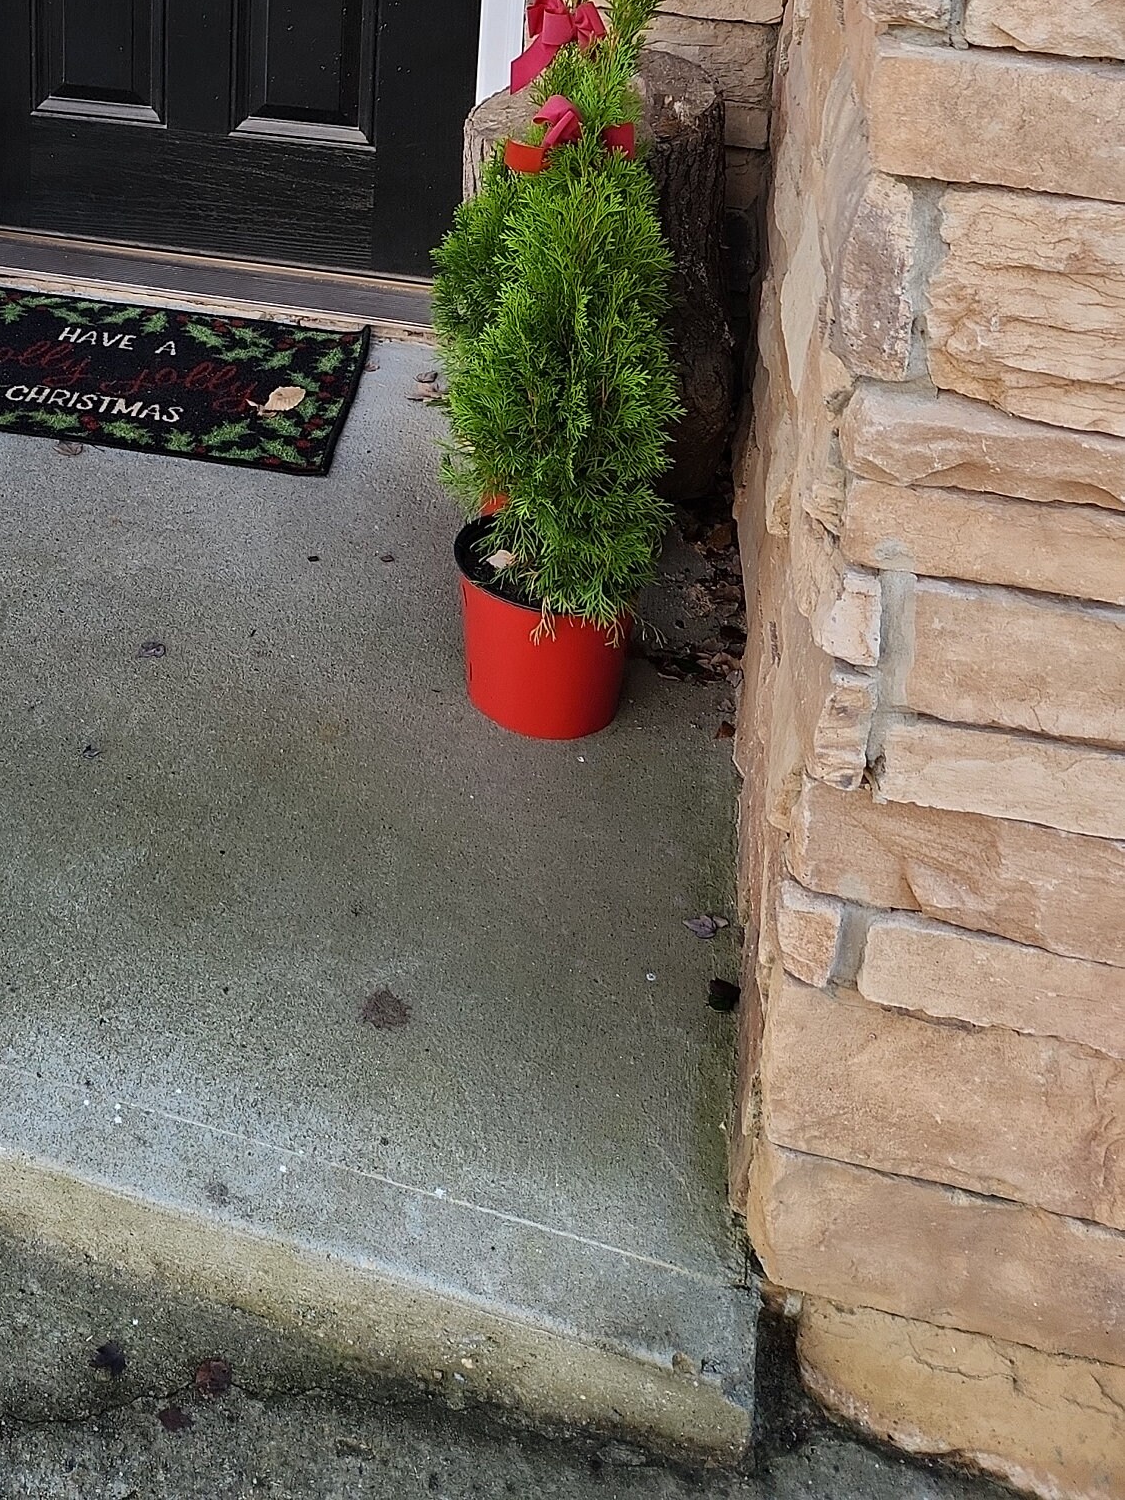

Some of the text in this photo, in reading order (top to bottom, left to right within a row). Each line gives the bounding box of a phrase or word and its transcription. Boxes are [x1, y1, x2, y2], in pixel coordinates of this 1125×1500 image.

[57, 326, 177, 356] HAVE A
[4, 384, 185, 423] CHRISTMAS
[98, 361, 258, 413] jolly
